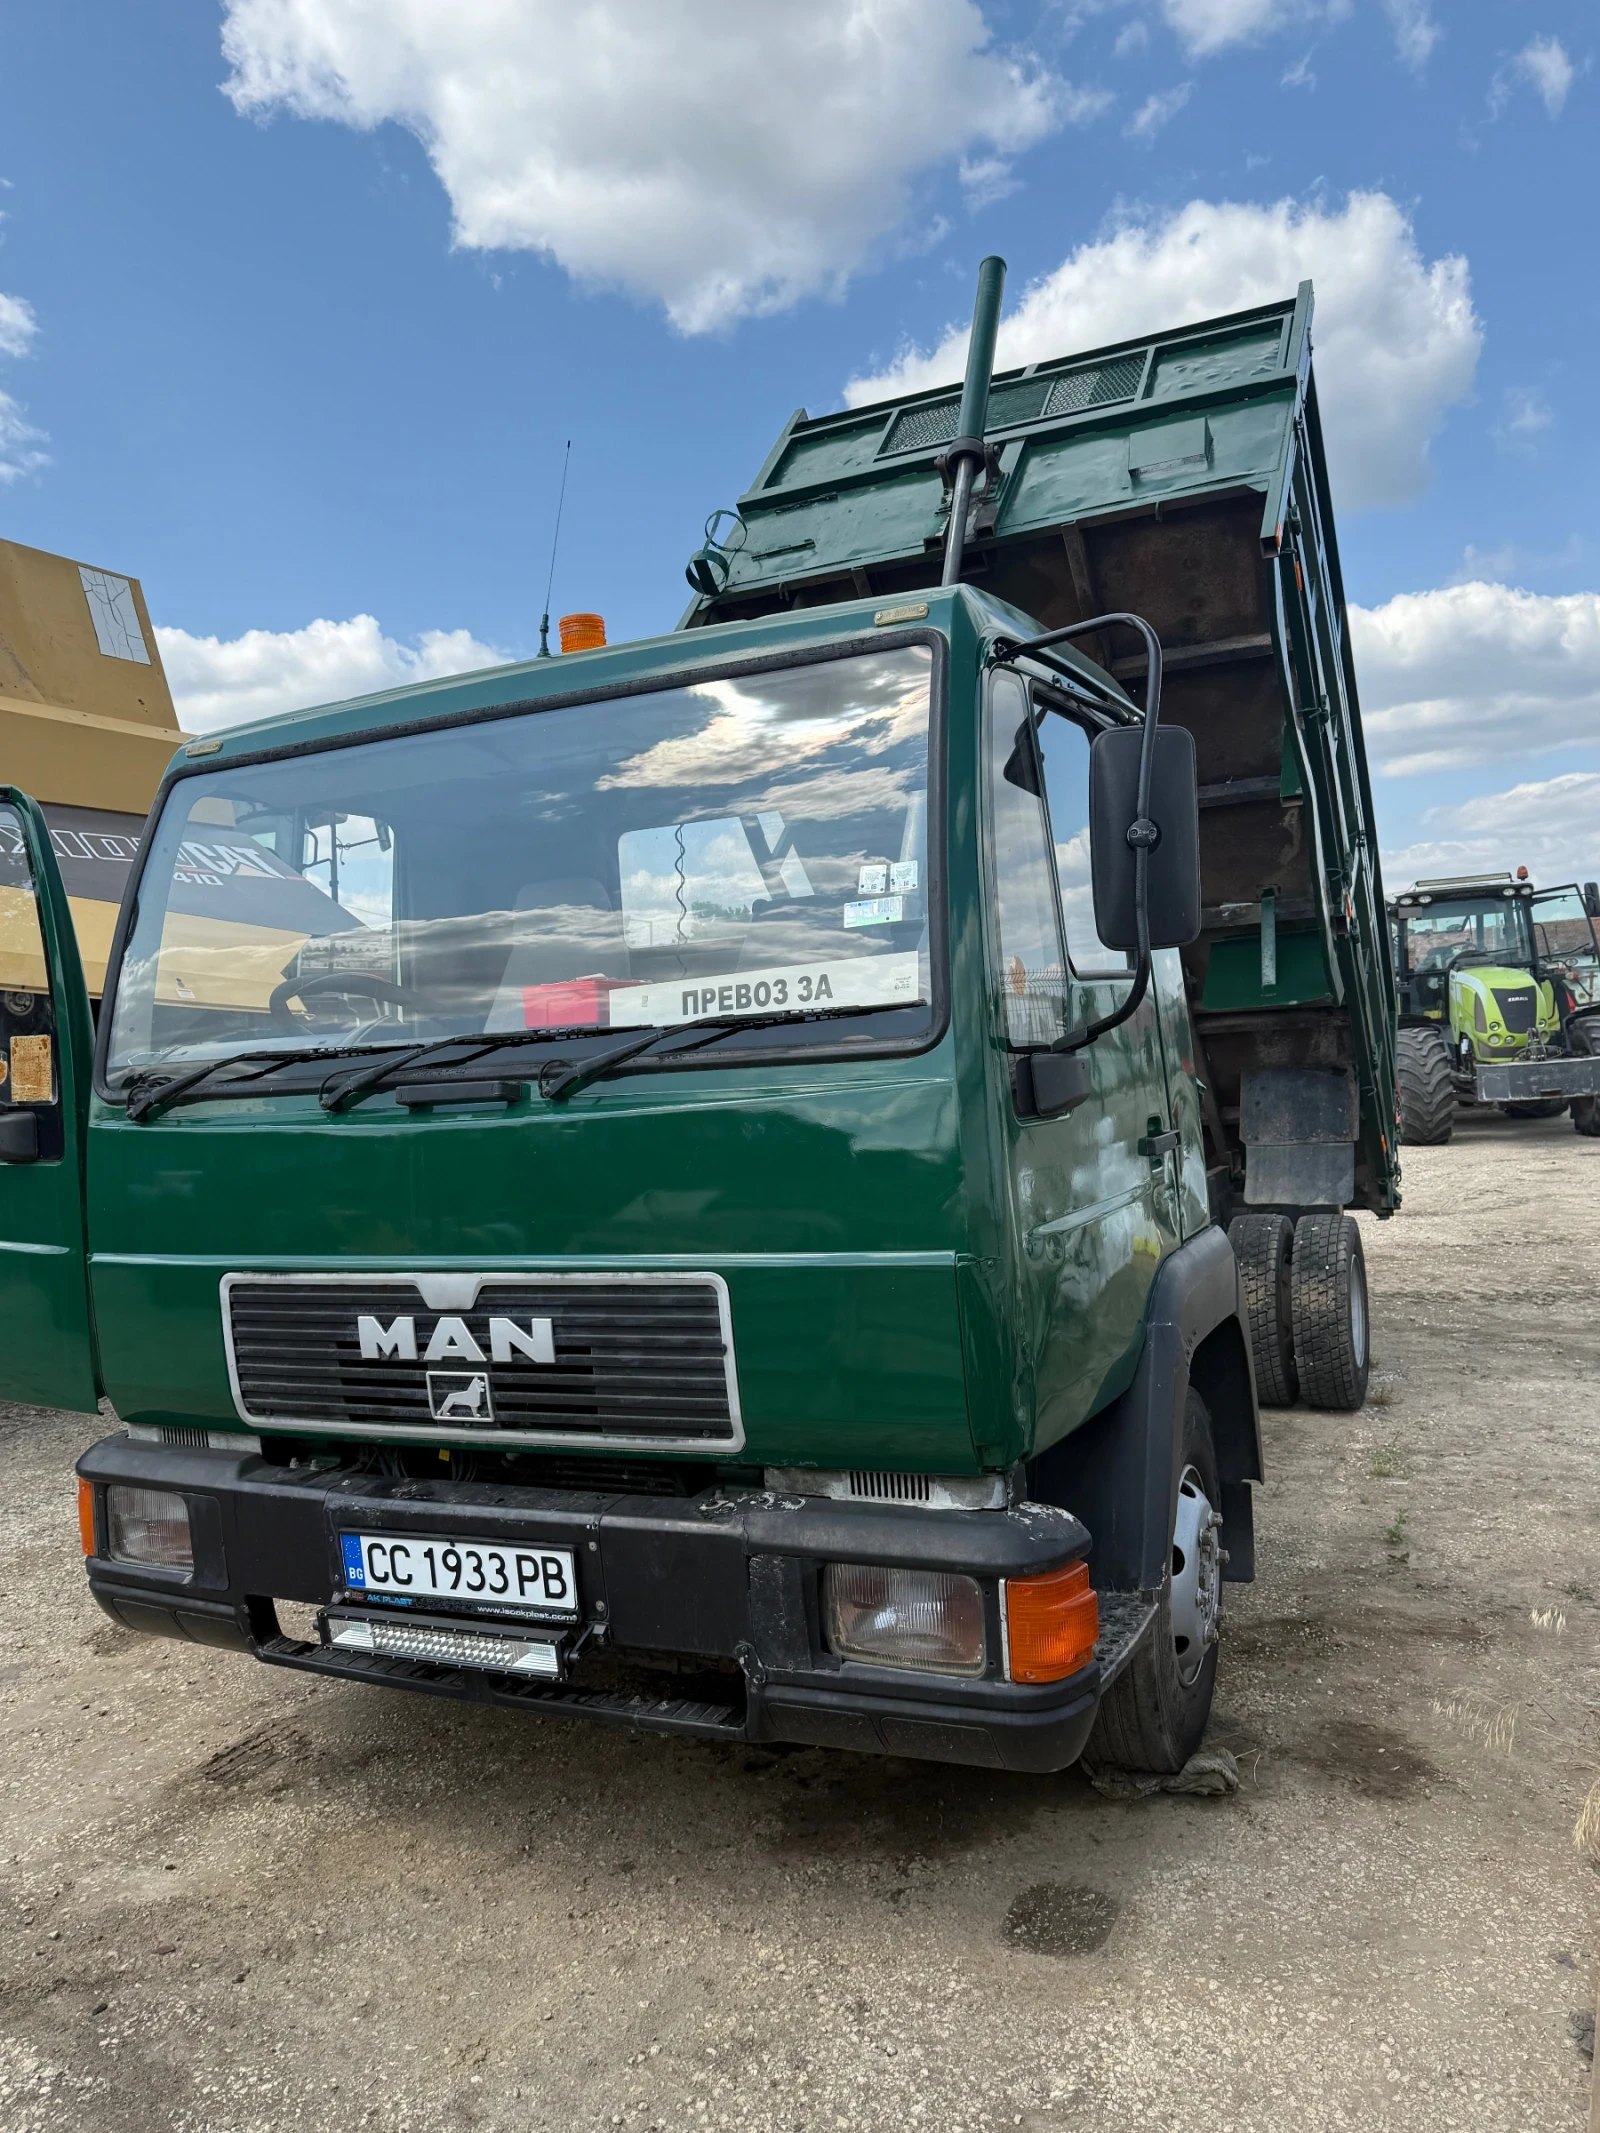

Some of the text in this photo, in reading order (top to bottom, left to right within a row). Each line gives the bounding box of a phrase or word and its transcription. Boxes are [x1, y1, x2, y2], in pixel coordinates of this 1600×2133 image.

[182, 842, 286, 879] CAT
[682, 973, 833, 1016] ПРЕВОЗ ЗА
[357, 1315, 556, 1364] MAN
[349, 1567, 364, 1580] BG
